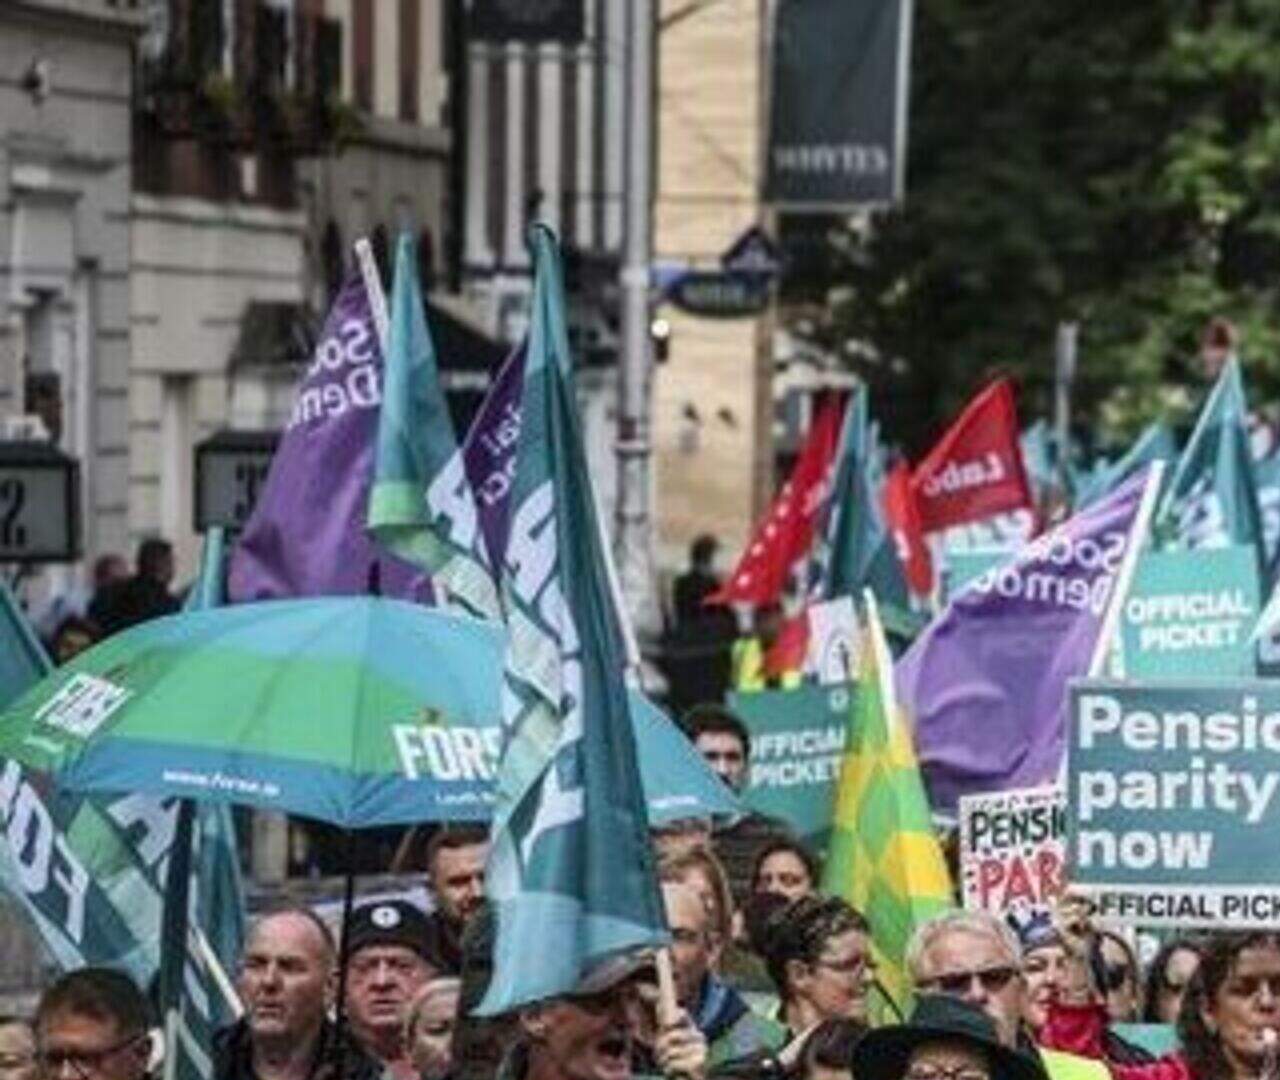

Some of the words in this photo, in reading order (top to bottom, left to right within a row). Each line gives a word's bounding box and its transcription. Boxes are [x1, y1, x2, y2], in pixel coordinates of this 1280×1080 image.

[1127, 589, 1249, 622] OFFICIAL
[1139, 620, 1241, 650] PICKET
[1079, 758, 1280, 822] parity
[1078, 828, 1214, 870] now
